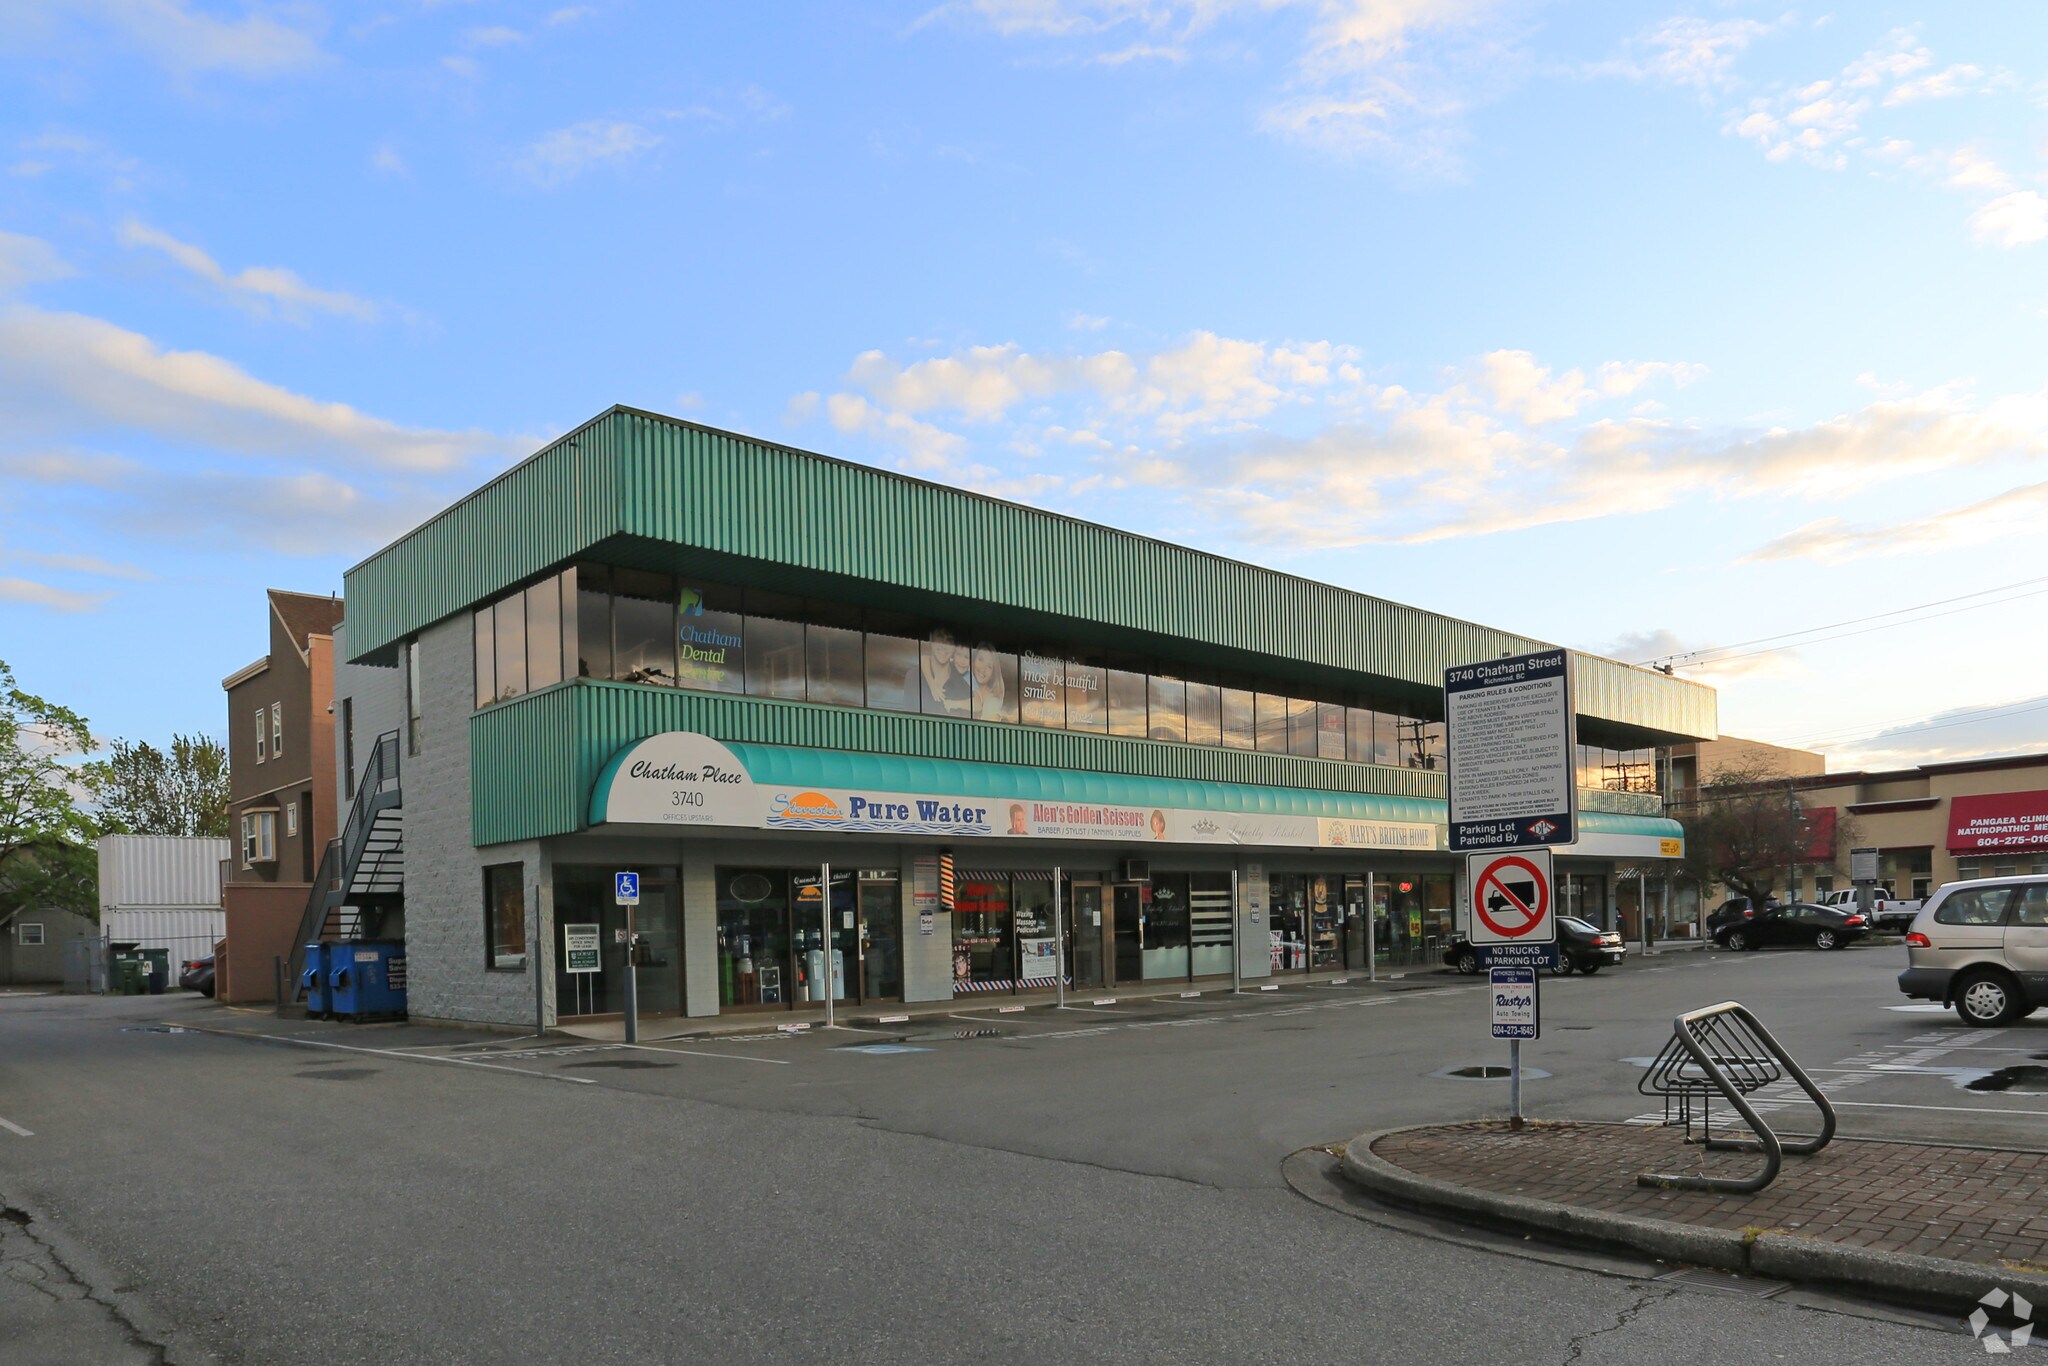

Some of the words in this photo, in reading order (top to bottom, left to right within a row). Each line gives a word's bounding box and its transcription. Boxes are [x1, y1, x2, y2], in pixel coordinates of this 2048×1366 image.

[681, 624, 742, 648] Chatham
[682, 644, 725, 663] Dental
[1024, 650, 1079, 670] Steveston's
[1450, 669, 1473, 682] 3740
[1477, 662, 1525, 678] Chatham
[1528, 655, 1562, 670] Street
[1024, 670, 1048, 684] most
[1053, 670, 1097, 692] beautiful
[1459, 691, 1484, 700] PARKING
[1486, 688, 1506, 696] RULES
[1514, 681, 1552, 692] CONDITIONS
[1024, 685, 1056, 700] smiles
[630, 760, 698, 782] Chatham
[702, 765, 742, 784] Place
[672, 791, 703, 806] 3740
[770, 793, 844, 816] Steveston
[850, 796, 909, 820] Pure
[916, 801, 986, 824] Water
[1033, 804, 1065, 823] Alen's
[1067, 805, 1102, 824] Golden
[1103, 808, 1144, 827] Scissors
[1460, 825, 1496, 835] Parking
[1499, 822, 1515, 831] Lot
[1957, 824, 2030, 835] NATUROPATHIC
[1970, 817, 2016, 826] PANGAEA
[1118, 829, 1142, 838] SUPPLIES
[1350, 824, 1378, 844] MARY'S
[1380, 826, 1408, 845] BRITISH
[1410, 828, 1429, 846] HOME
[1460, 834, 1503, 845] Patrolled
[1506, 832, 1519, 843] By
[794, 876, 816, 884] Quench
[1496, 995, 1531, 1009] Rusty's
